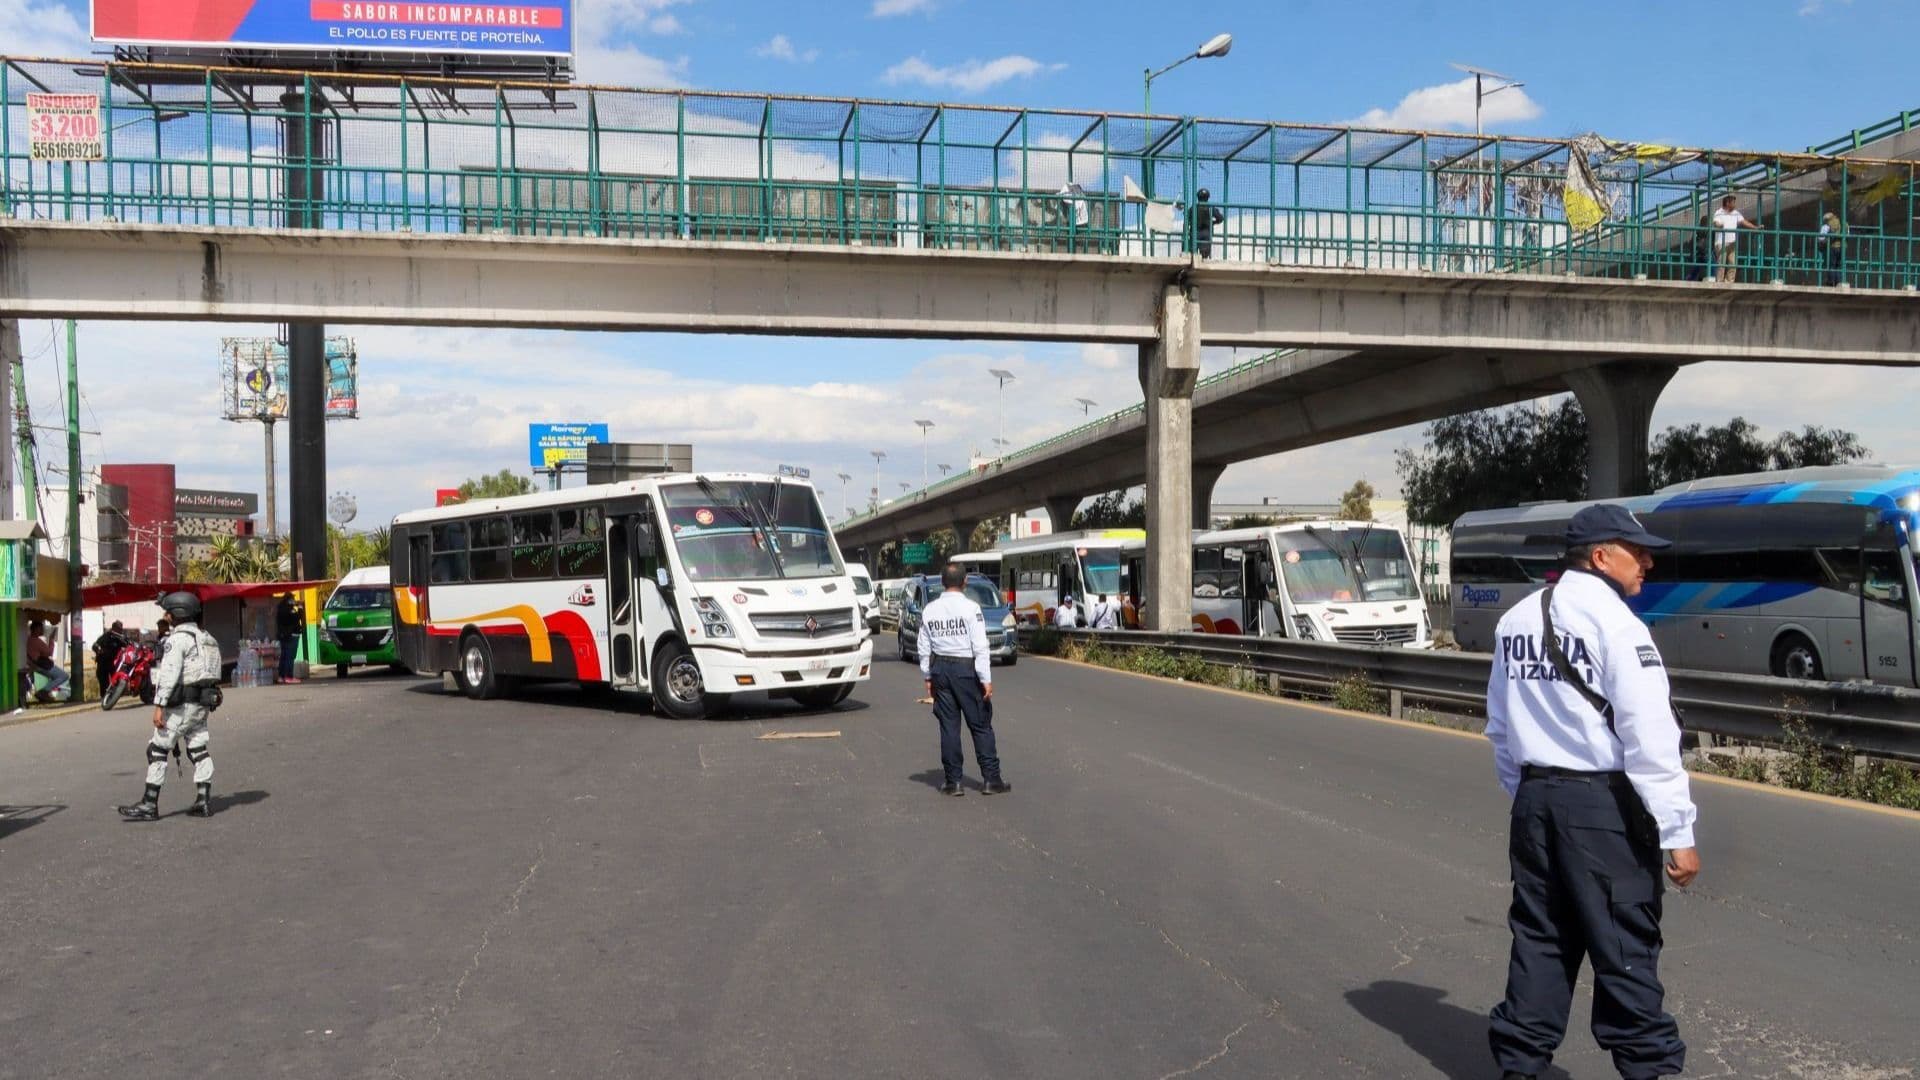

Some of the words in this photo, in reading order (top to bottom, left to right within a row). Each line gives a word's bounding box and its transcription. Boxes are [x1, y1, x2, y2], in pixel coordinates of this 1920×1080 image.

[343, 3, 398, 20] SABOR
[407, 5, 539, 25] INCOMPARABLE
[329, 27, 344, 38] EL
[347, 28, 387, 39] POLLO
[390, 29, 407, 40] ES
[410, 30, 458, 41] FUENTE
[461, 31, 477, 42] DE
[481, 30, 544, 44] PROTEÍNA.
[28, 94, 97, 108] DIVORCIO
[31, 115, 97, 138] $3,200
[33, 142, 101, 159] 5561669210
[1462, 585, 1500, 608] Pegasso
[1521, 664, 1593, 685] IZCAI
